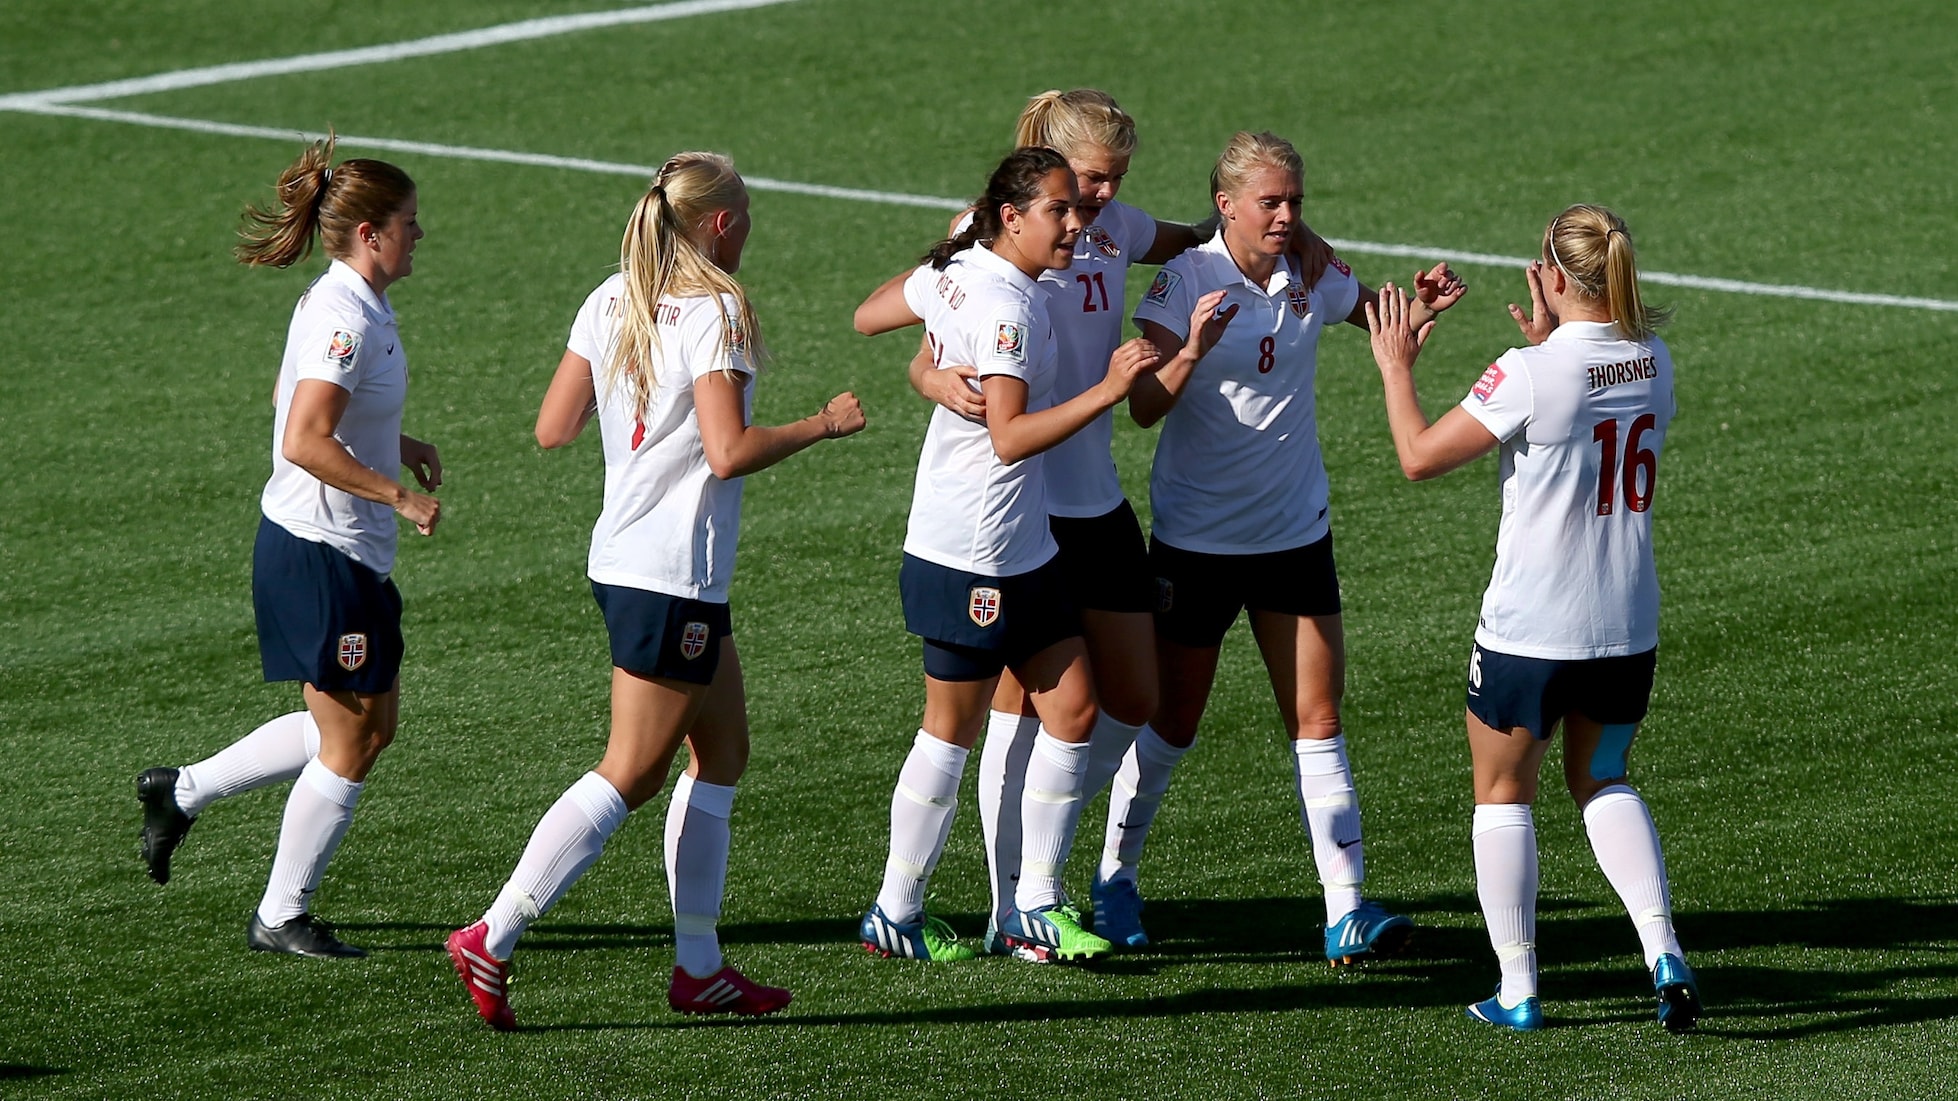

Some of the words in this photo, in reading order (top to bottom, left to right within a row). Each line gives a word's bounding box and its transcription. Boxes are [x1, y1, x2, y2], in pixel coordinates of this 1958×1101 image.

[1076, 271, 1109, 312] 21
[1257, 336, 1276, 374] 8
[1587, 356, 1658, 389] THORSNES
[1593, 413, 1657, 517] 16
